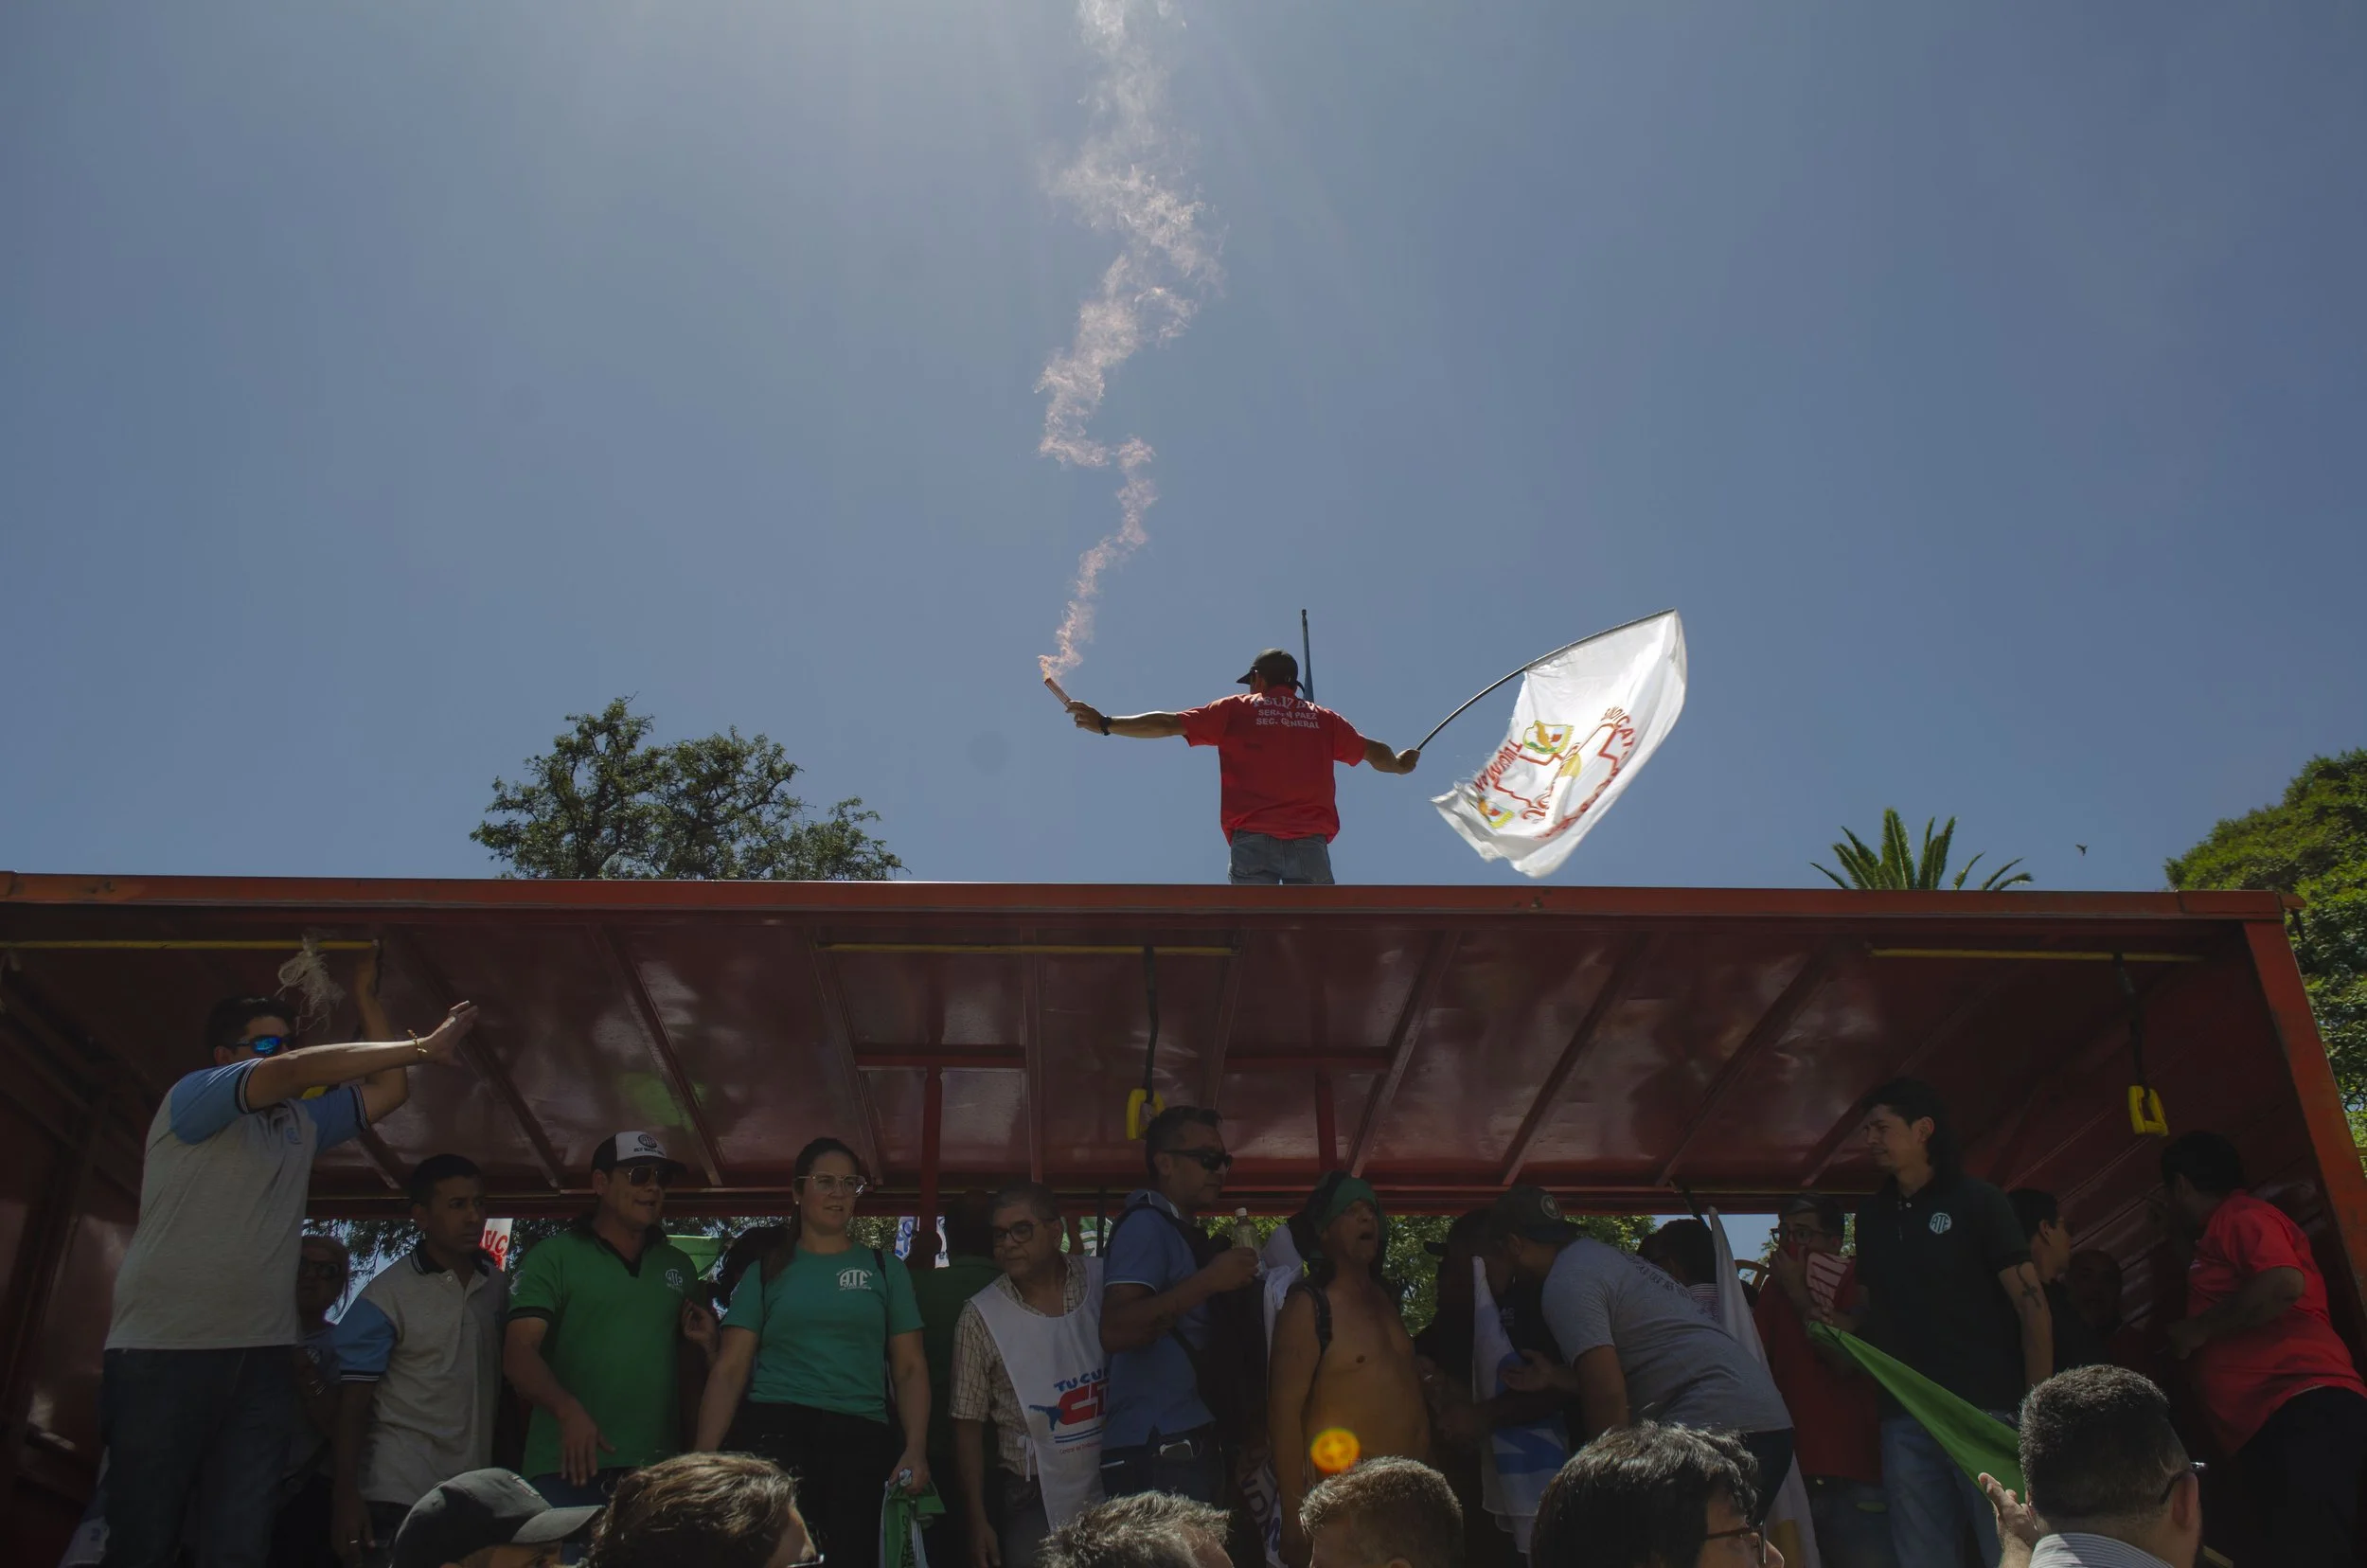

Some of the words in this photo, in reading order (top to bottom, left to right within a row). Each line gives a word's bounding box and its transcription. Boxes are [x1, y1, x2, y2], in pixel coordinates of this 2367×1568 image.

[1255, 717, 1278, 725] SEC.
[1294, 711, 1317, 720] PAEZ
[1930, 1213, 1951, 1234] ATE
[839, 1269, 870, 1289] ATE
[1053, 1367, 1110, 1392] TUCU
